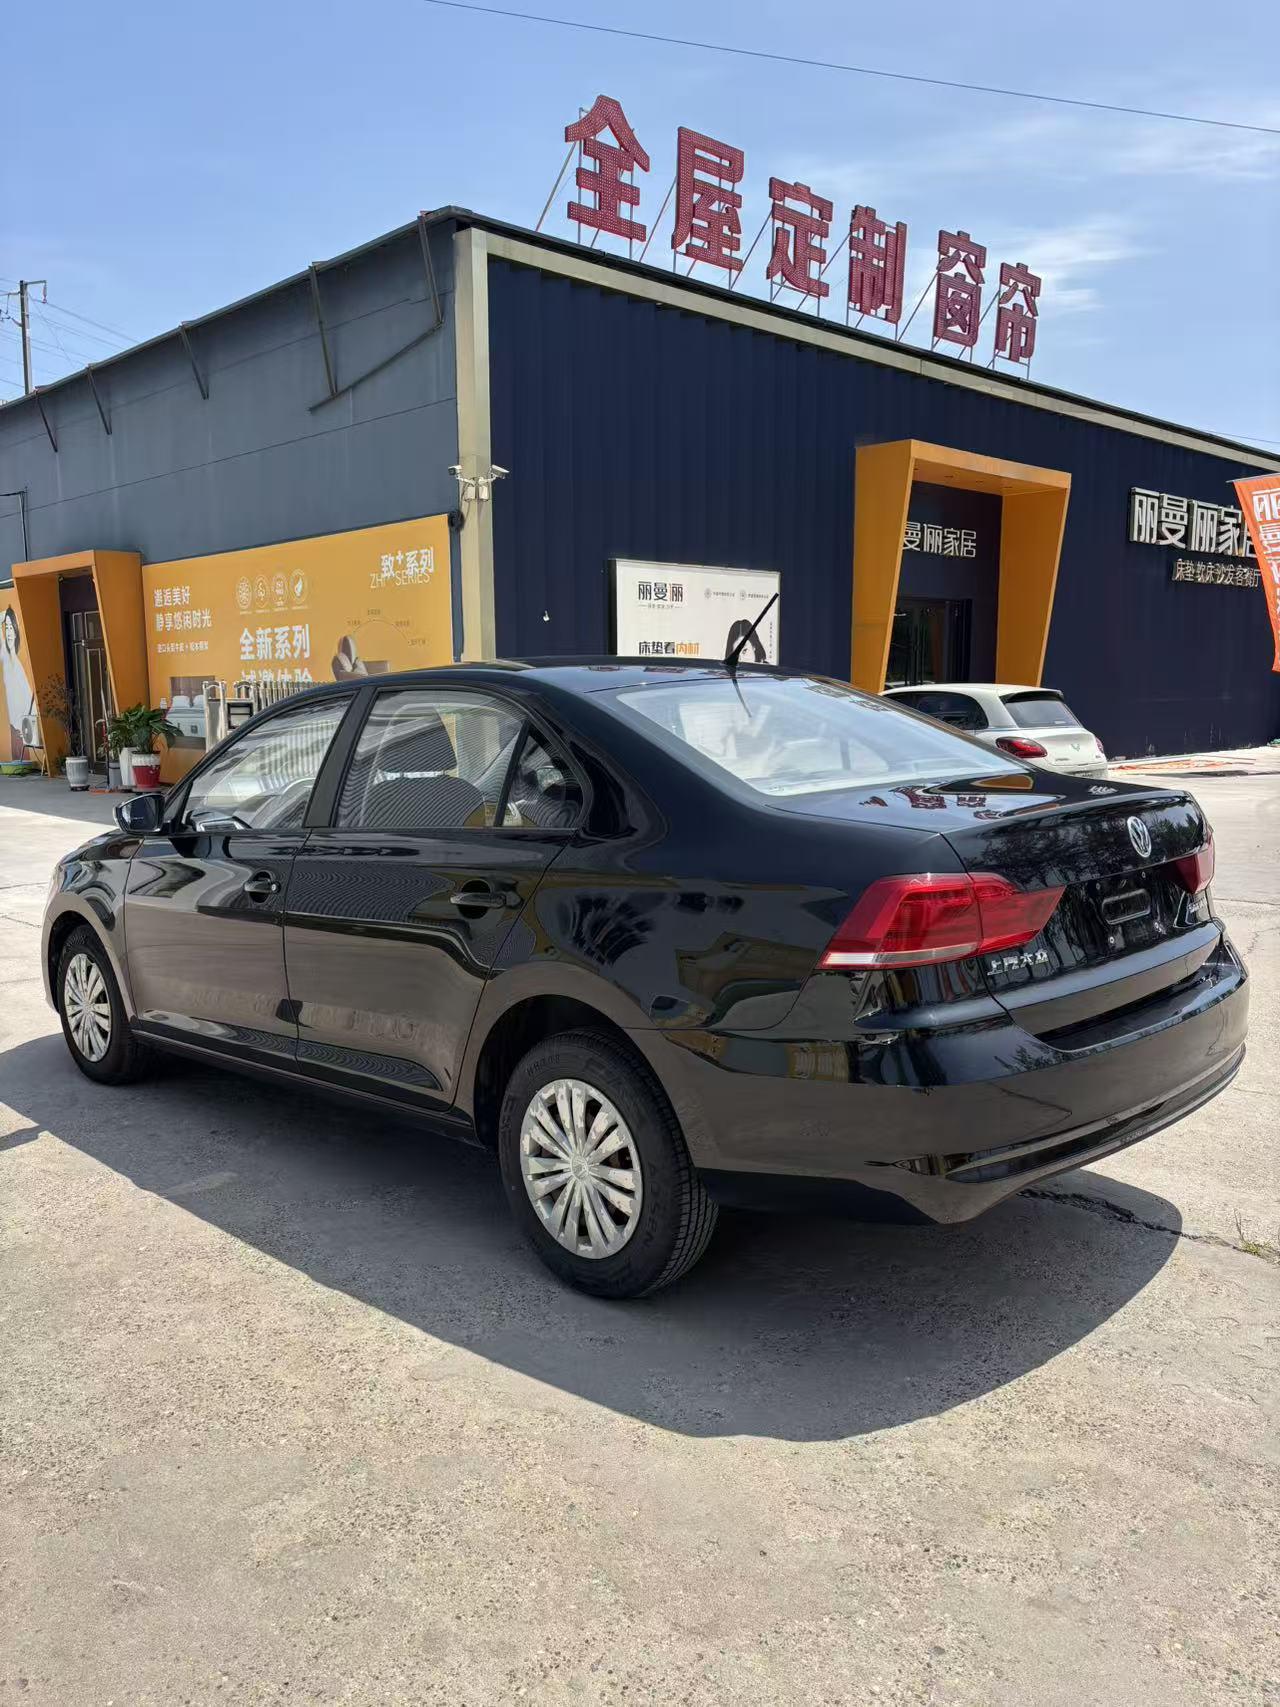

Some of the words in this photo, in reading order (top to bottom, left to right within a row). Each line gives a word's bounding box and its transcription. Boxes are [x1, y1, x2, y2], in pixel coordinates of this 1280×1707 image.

[564, 94, 1042, 362] 全屋定制窗帘
[240, 623, 310, 660] 全新系列
[986, 949, 1049, 976] 上汽大众
